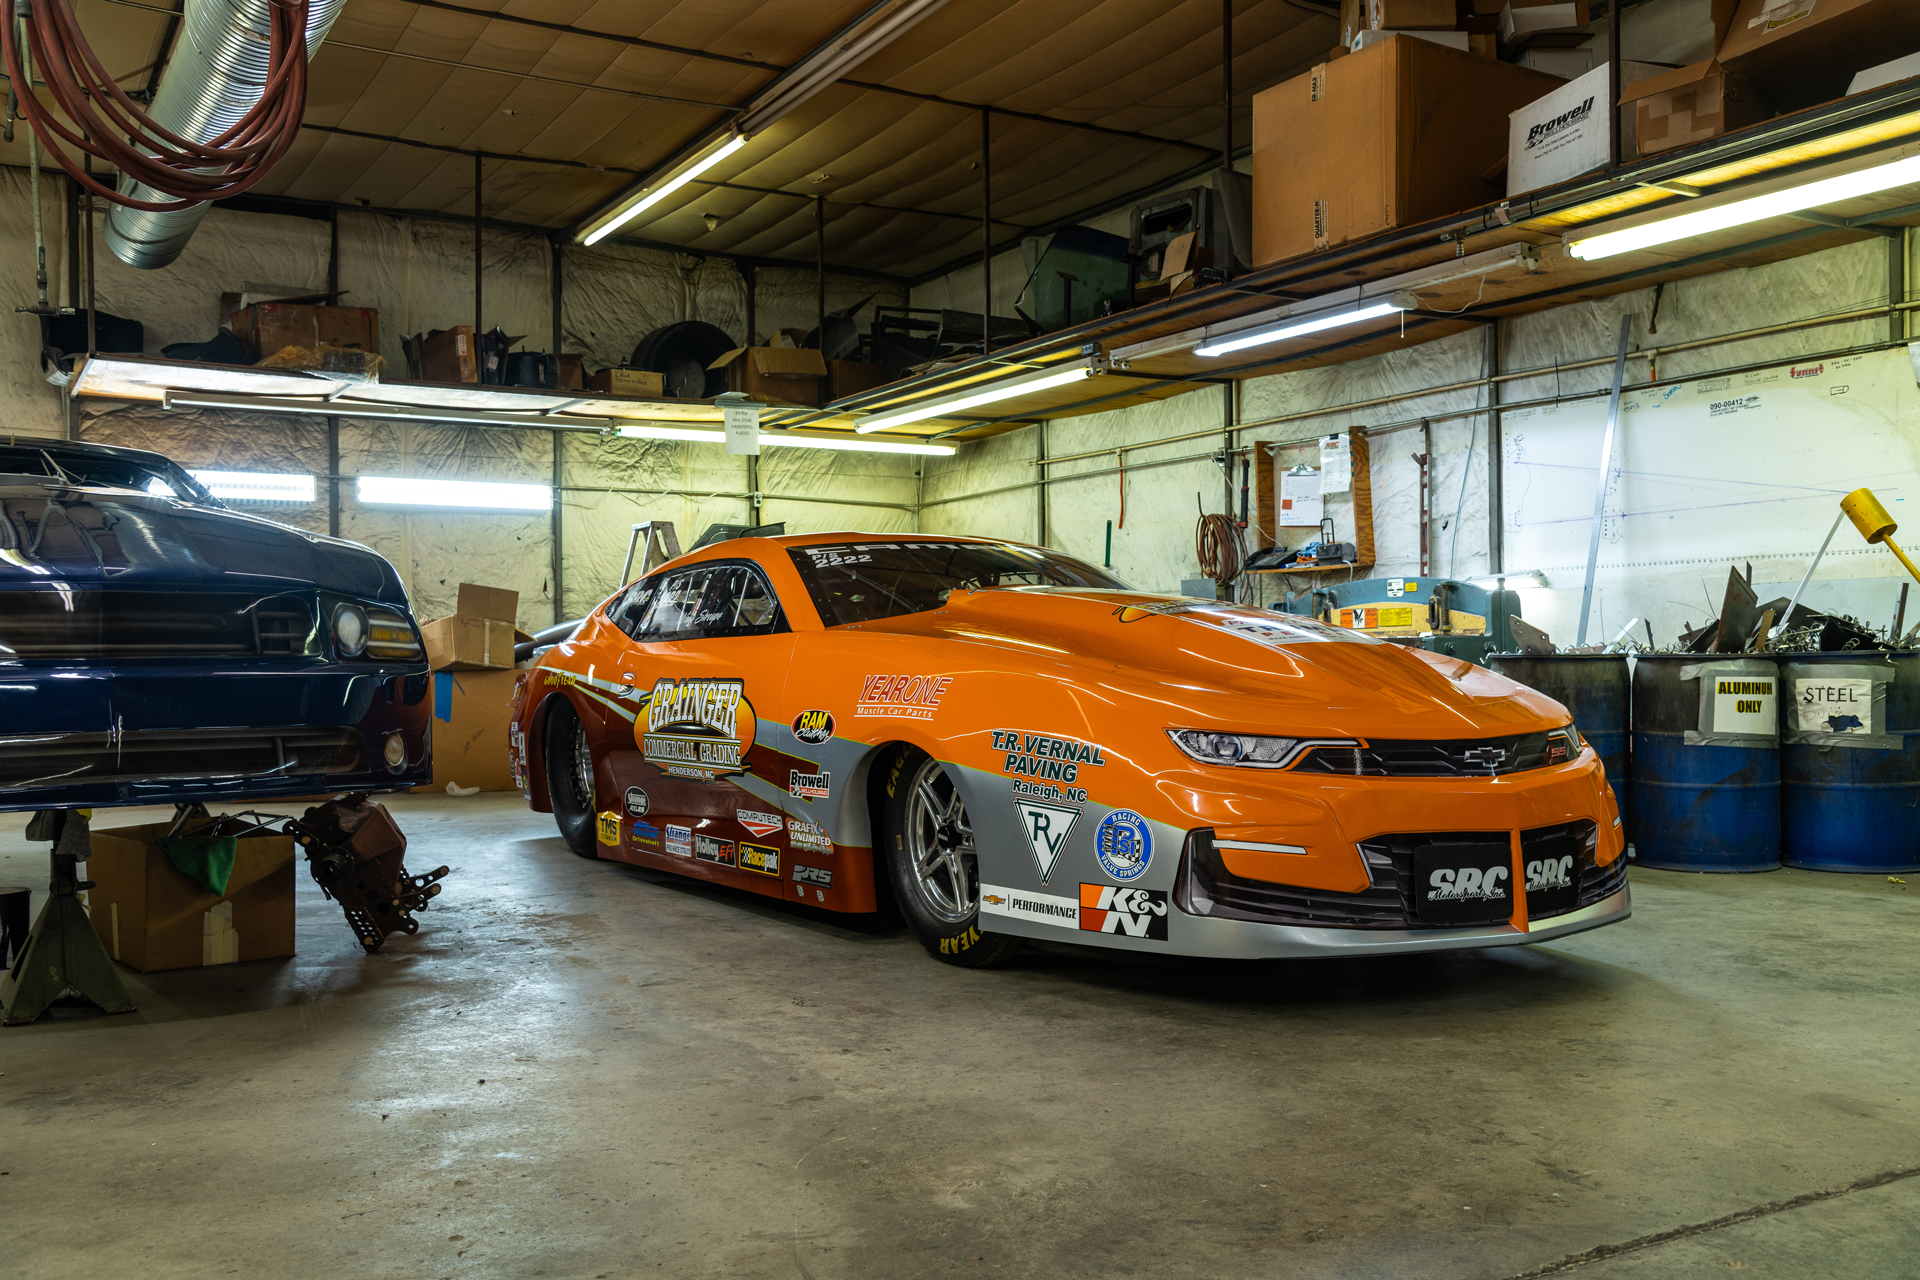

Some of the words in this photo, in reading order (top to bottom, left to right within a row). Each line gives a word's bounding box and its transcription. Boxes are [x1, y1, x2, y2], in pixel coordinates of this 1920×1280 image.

[1527, 95, 1595, 142] Browell
[1710, 398, 1743, 410] 090-00412
[812, 552, 838, 560] P/S
[814, 554, 872, 568] 2222
[858, 675, 954, 706] YEARONE
[1717, 682, 1772, 695] ALUMINUM
[1805, 686, 1858, 702] STEEL
[648, 682, 742, 740] GRAINGER
[857, 707, 884, 715] Muscle
[906, 708, 933, 718] Parts
[1736, 700, 1762, 713] ONLY
[800, 711, 829, 730] RAM
[643, 738, 697, 761] COMMERCIAL
[700, 742, 741, 766] GRADING
[992, 730, 1022, 754] T.R.
[1024, 734, 1106, 766] VERNAL
[668, 765, 705, 780] HENDERSON,
[705, 770, 715, 780] NC
[1004, 752, 1079, 784] PAVING
[791, 771, 829, 789] Browell
[1012, 778, 1064, 803] Raleigh,
[1066, 788, 1088, 804] NC
[600, 817, 617, 835] TMS
[738, 811, 782, 825] COMPUTECH
[788, 820, 819, 834] GRAFIX
[1112, 813, 1141, 826] RACING
[632, 836, 660, 846] Driveshaft
[666, 826, 690, 842] Strange
[790, 831, 831, 846] UNLIMITED
[1111, 825, 1136, 855] PSI
[696, 836, 719, 861] Holley
[748, 848, 778, 872] Racepak
[1101, 855, 1118, 875] VALVE
[1120, 860, 1145, 877] SPRINGS
[1526, 855, 1573, 887] SRC
[1428, 866, 1508, 895] SRC
[1012, 898, 1077, 920] PERFORMANCE
